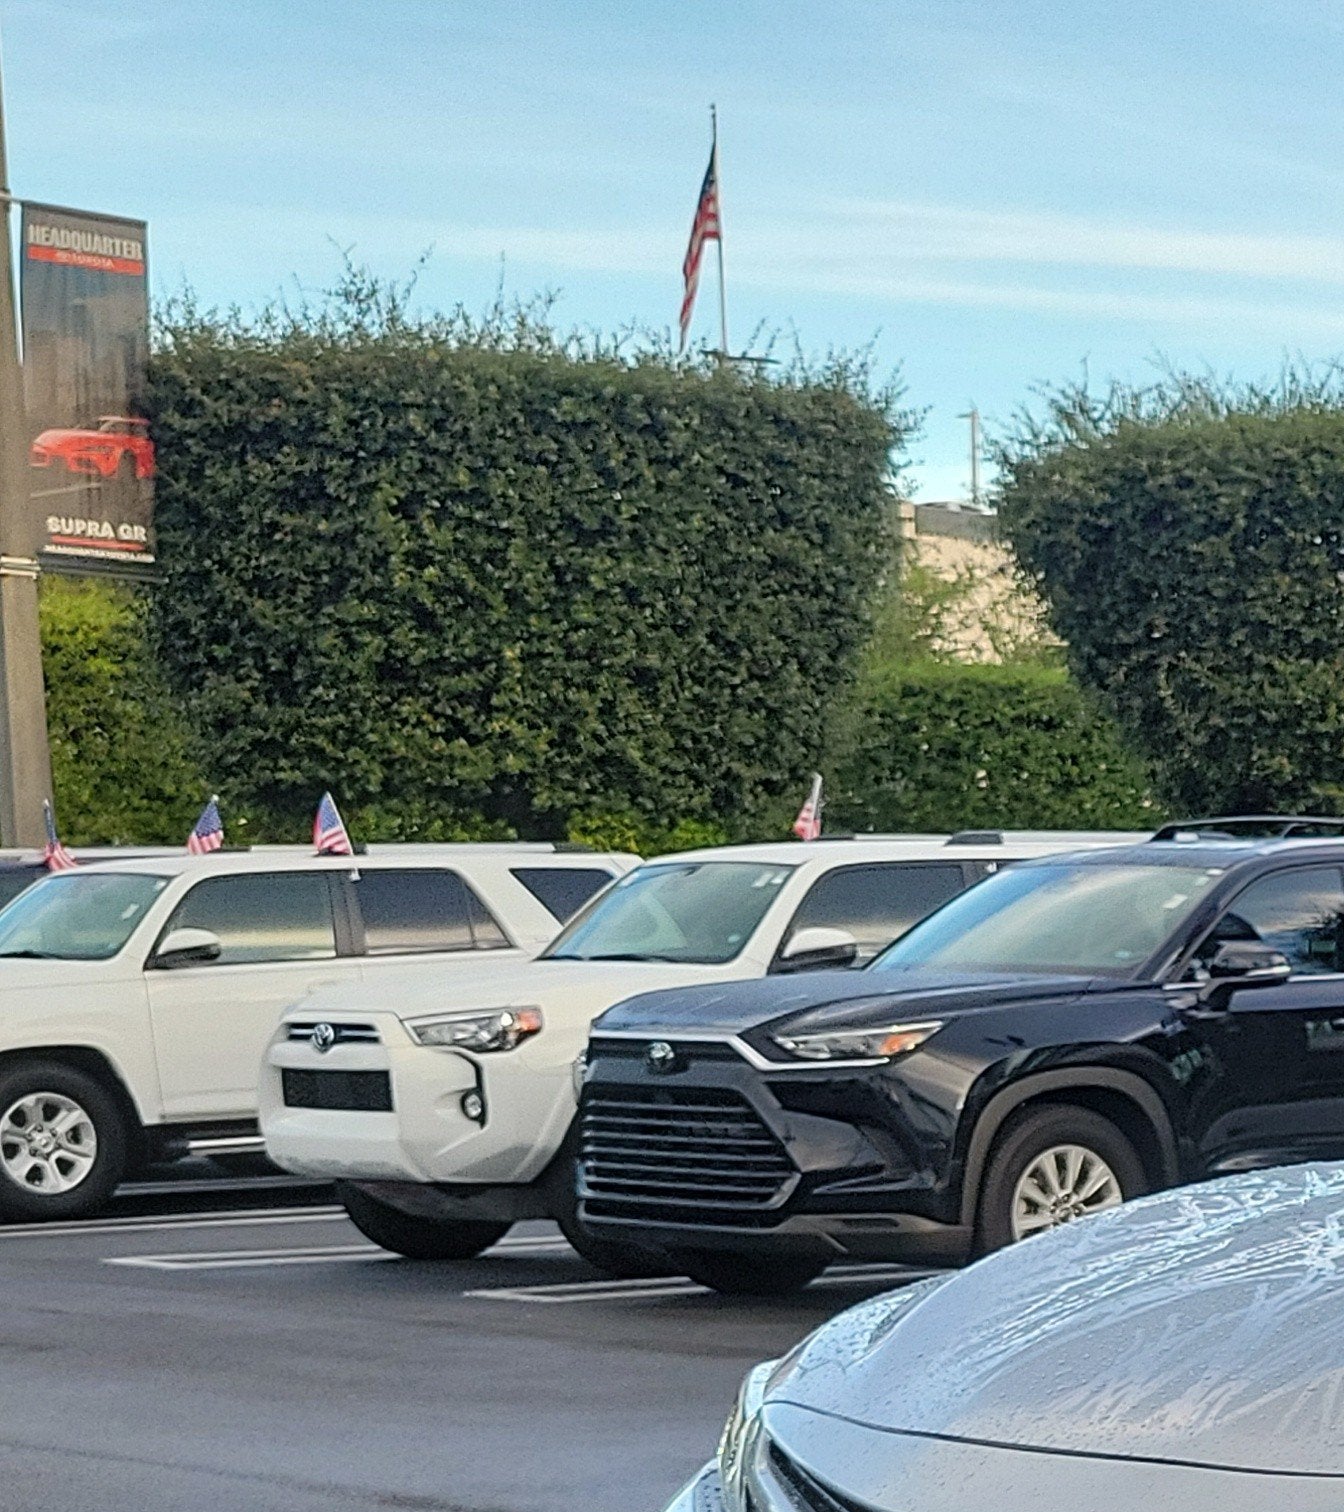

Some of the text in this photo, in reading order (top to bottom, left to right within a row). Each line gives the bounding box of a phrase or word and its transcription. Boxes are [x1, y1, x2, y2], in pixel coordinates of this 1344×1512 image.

[28, 224, 143, 260] HEADQUARTER
[46, 516, 147, 542] SUPRA GR
